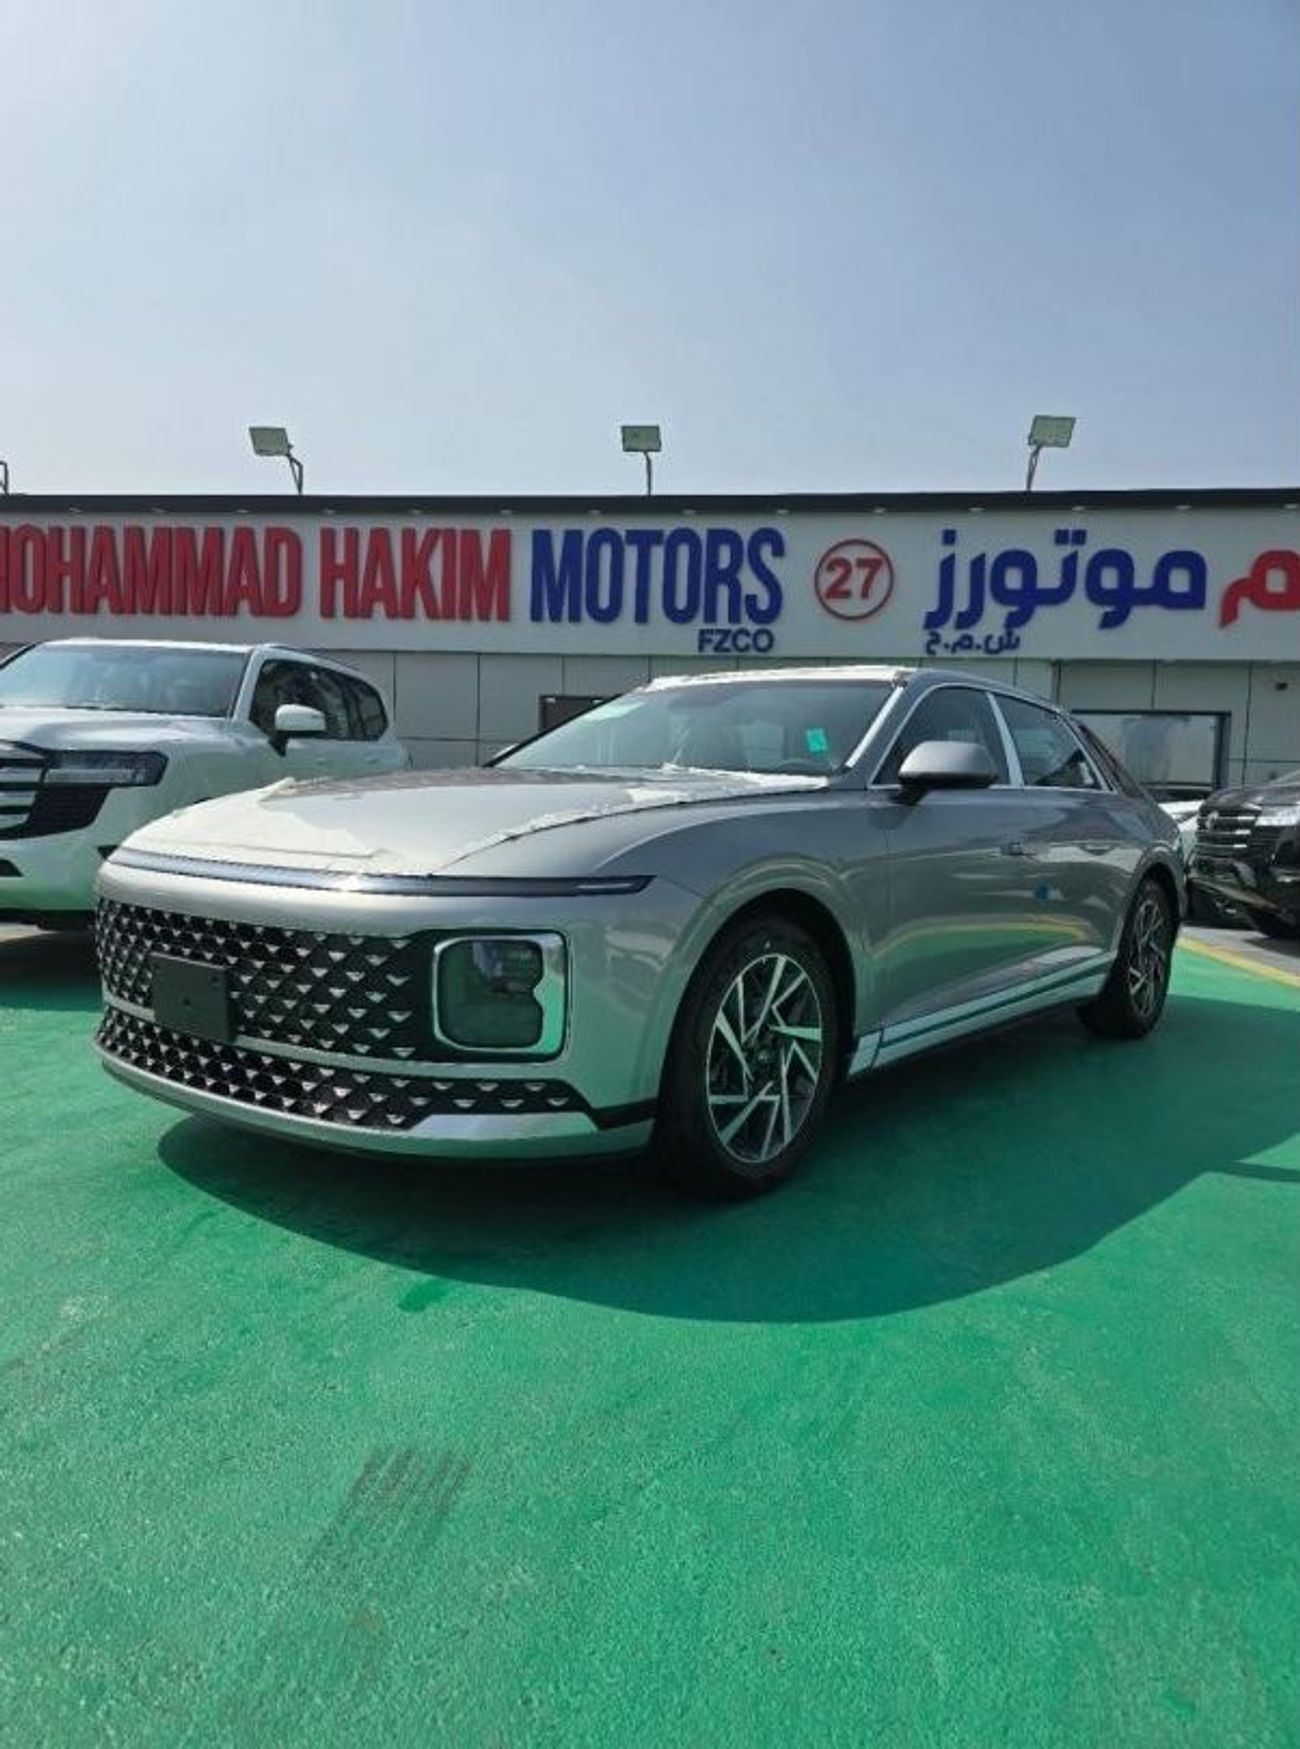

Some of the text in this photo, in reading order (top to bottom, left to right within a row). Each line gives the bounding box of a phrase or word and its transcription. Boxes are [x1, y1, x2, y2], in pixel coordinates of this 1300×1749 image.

[0, 523, 786, 625] OHAMMAD HAKIM MOTORS
[824, 557, 883, 600] 27
[923, 529, 1207, 630] موتورز
[698, 628, 775, 653] FZCO
